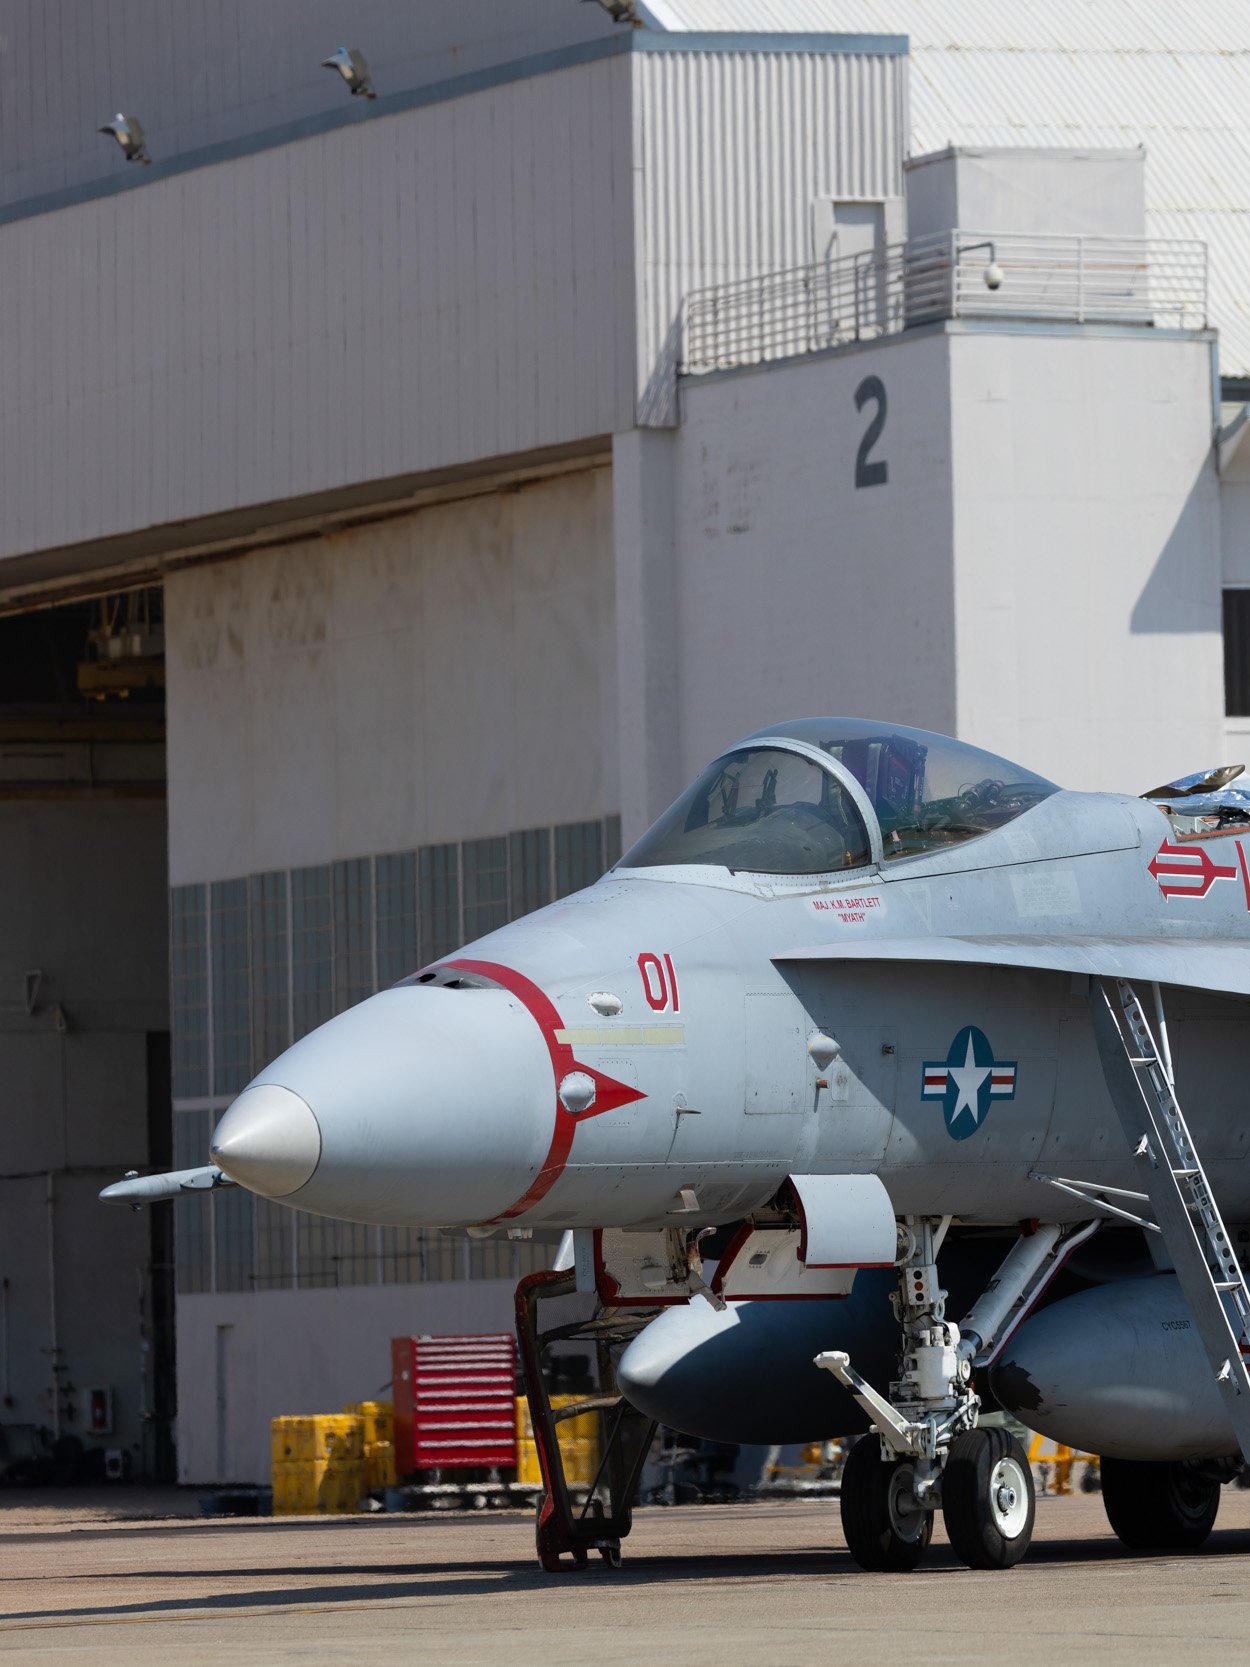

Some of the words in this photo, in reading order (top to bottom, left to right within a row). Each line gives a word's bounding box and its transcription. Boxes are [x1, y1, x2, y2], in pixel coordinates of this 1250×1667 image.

[854, 374, 888, 489] 2
[846, 897, 881, 909] BARTLETT
[637, 952, 681, 1014] 01
